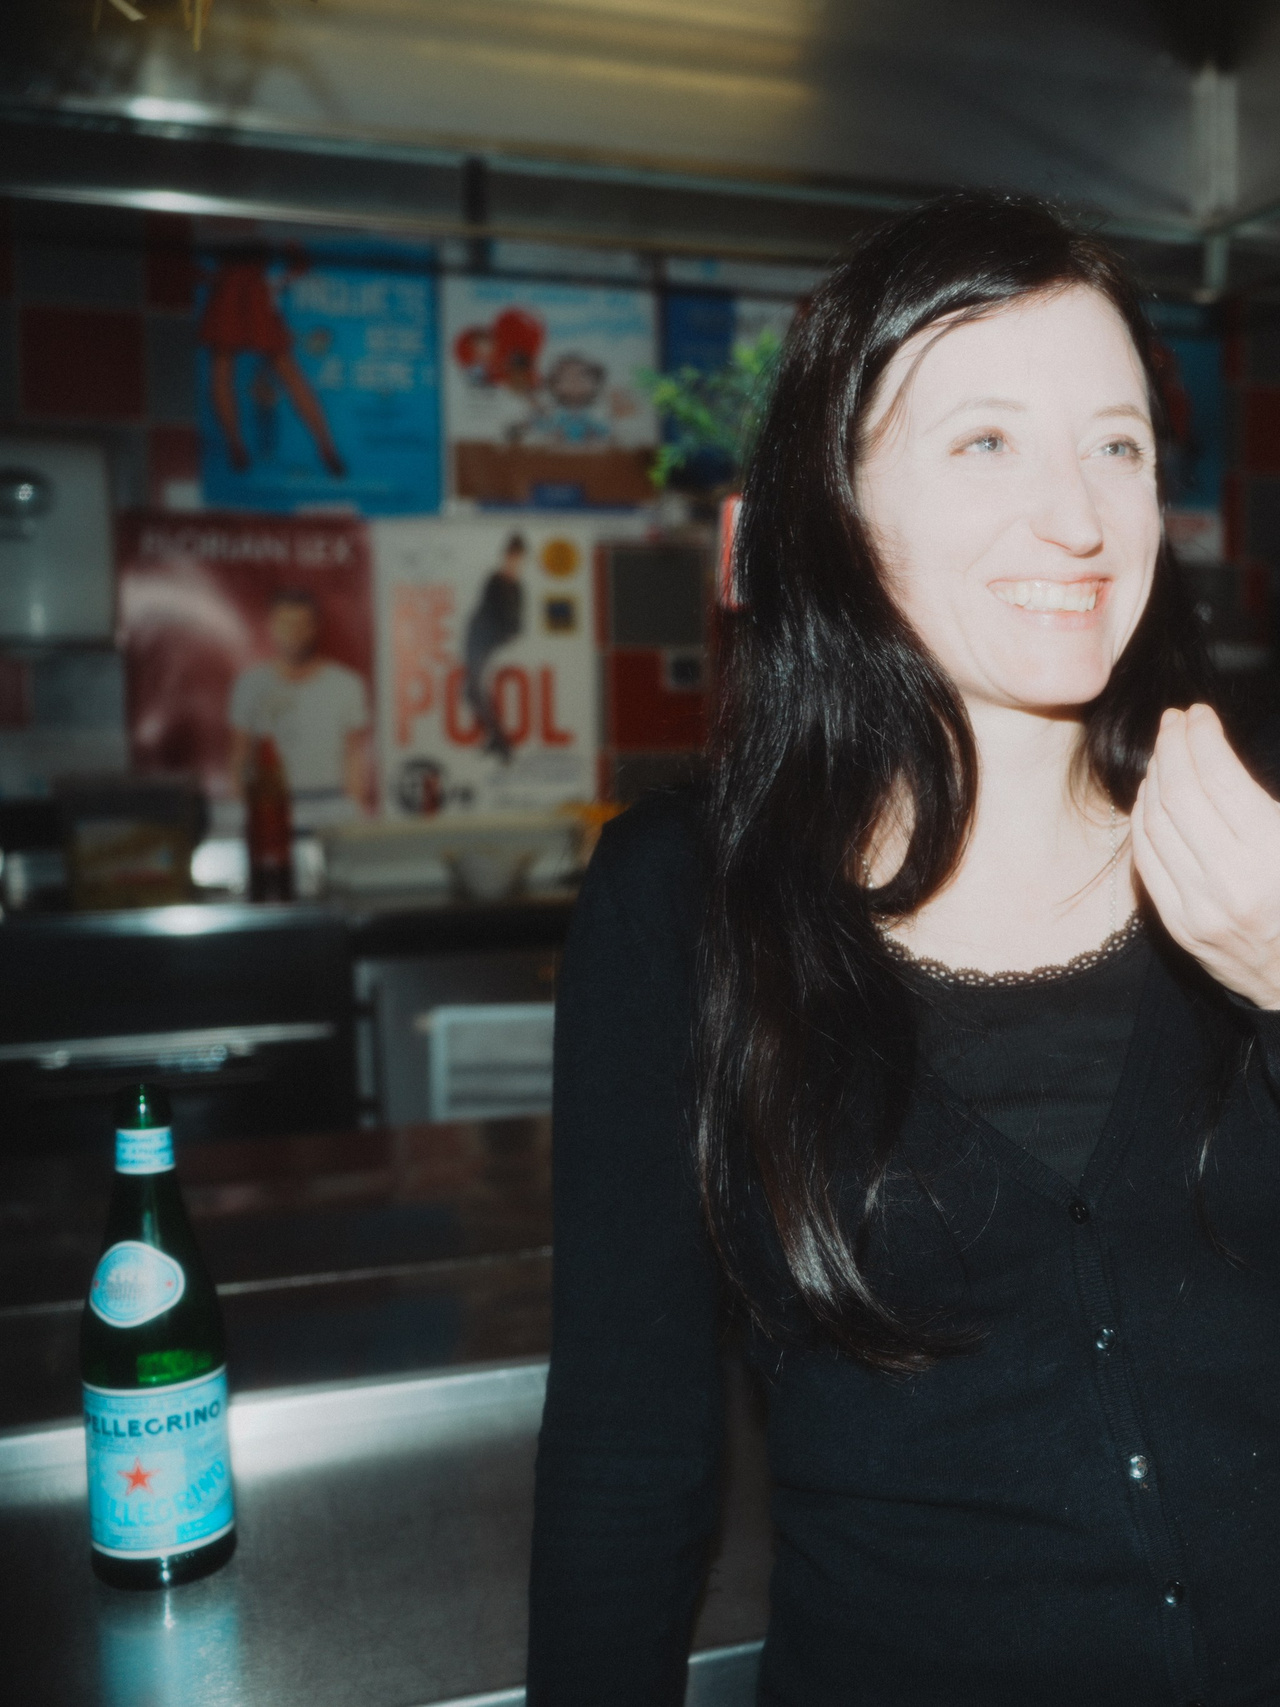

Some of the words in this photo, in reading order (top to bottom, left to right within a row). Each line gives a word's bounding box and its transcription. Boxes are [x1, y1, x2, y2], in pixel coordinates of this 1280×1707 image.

[139, 527, 289, 562] FLORIAN
[295, 531, 355, 567] LEX
[394, 664, 576, 747] POOL
[85, 1400, 221, 1437] PELLEGRINO
